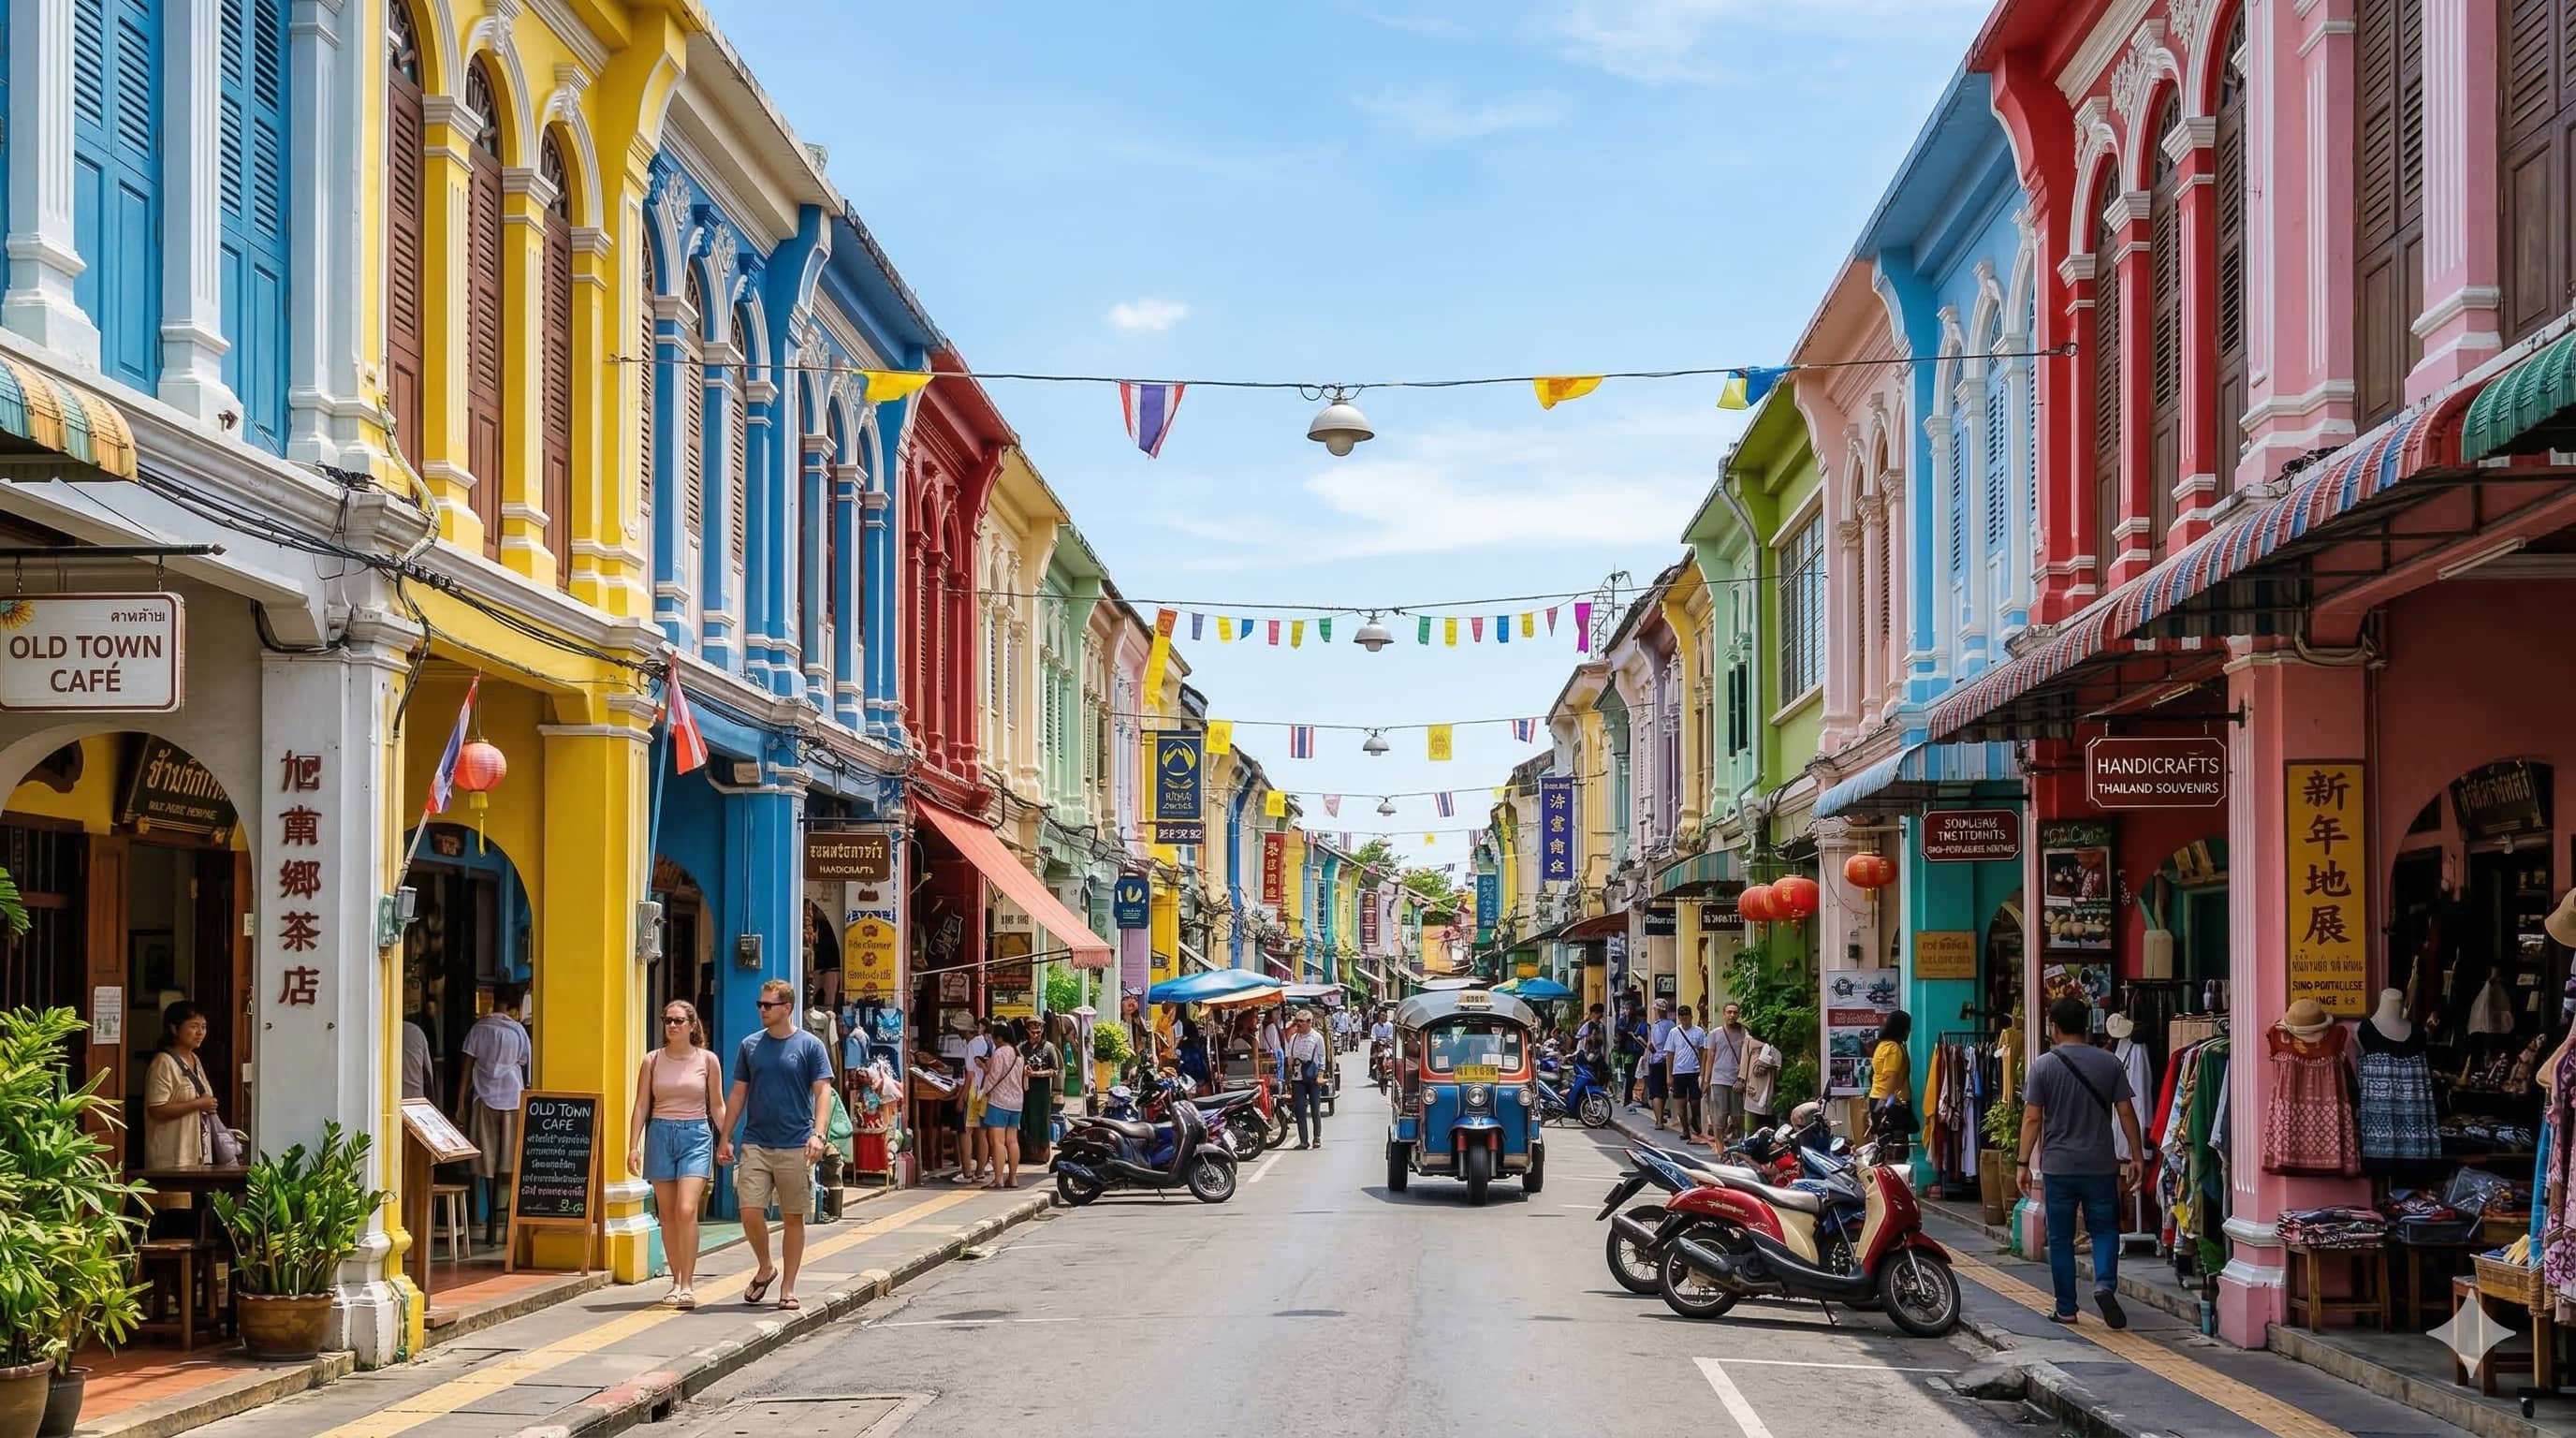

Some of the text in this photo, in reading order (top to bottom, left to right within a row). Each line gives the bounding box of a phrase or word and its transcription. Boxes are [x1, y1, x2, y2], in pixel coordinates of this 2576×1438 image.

[9, 635, 162, 659] OLD TOWN
[50, 661, 121, 693] CAFÉ
[2098, 756, 2219, 775] HANDICRAFTS
[2098, 783, 2219, 794] THAILAND SOUVENIRS
[2302, 770, 2352, 946] 新年地展
[2292, 980, 2313, 990] SINO
[529, 1102, 555, 1116] OLD
[542, 1118, 575, 1131] CAFE
